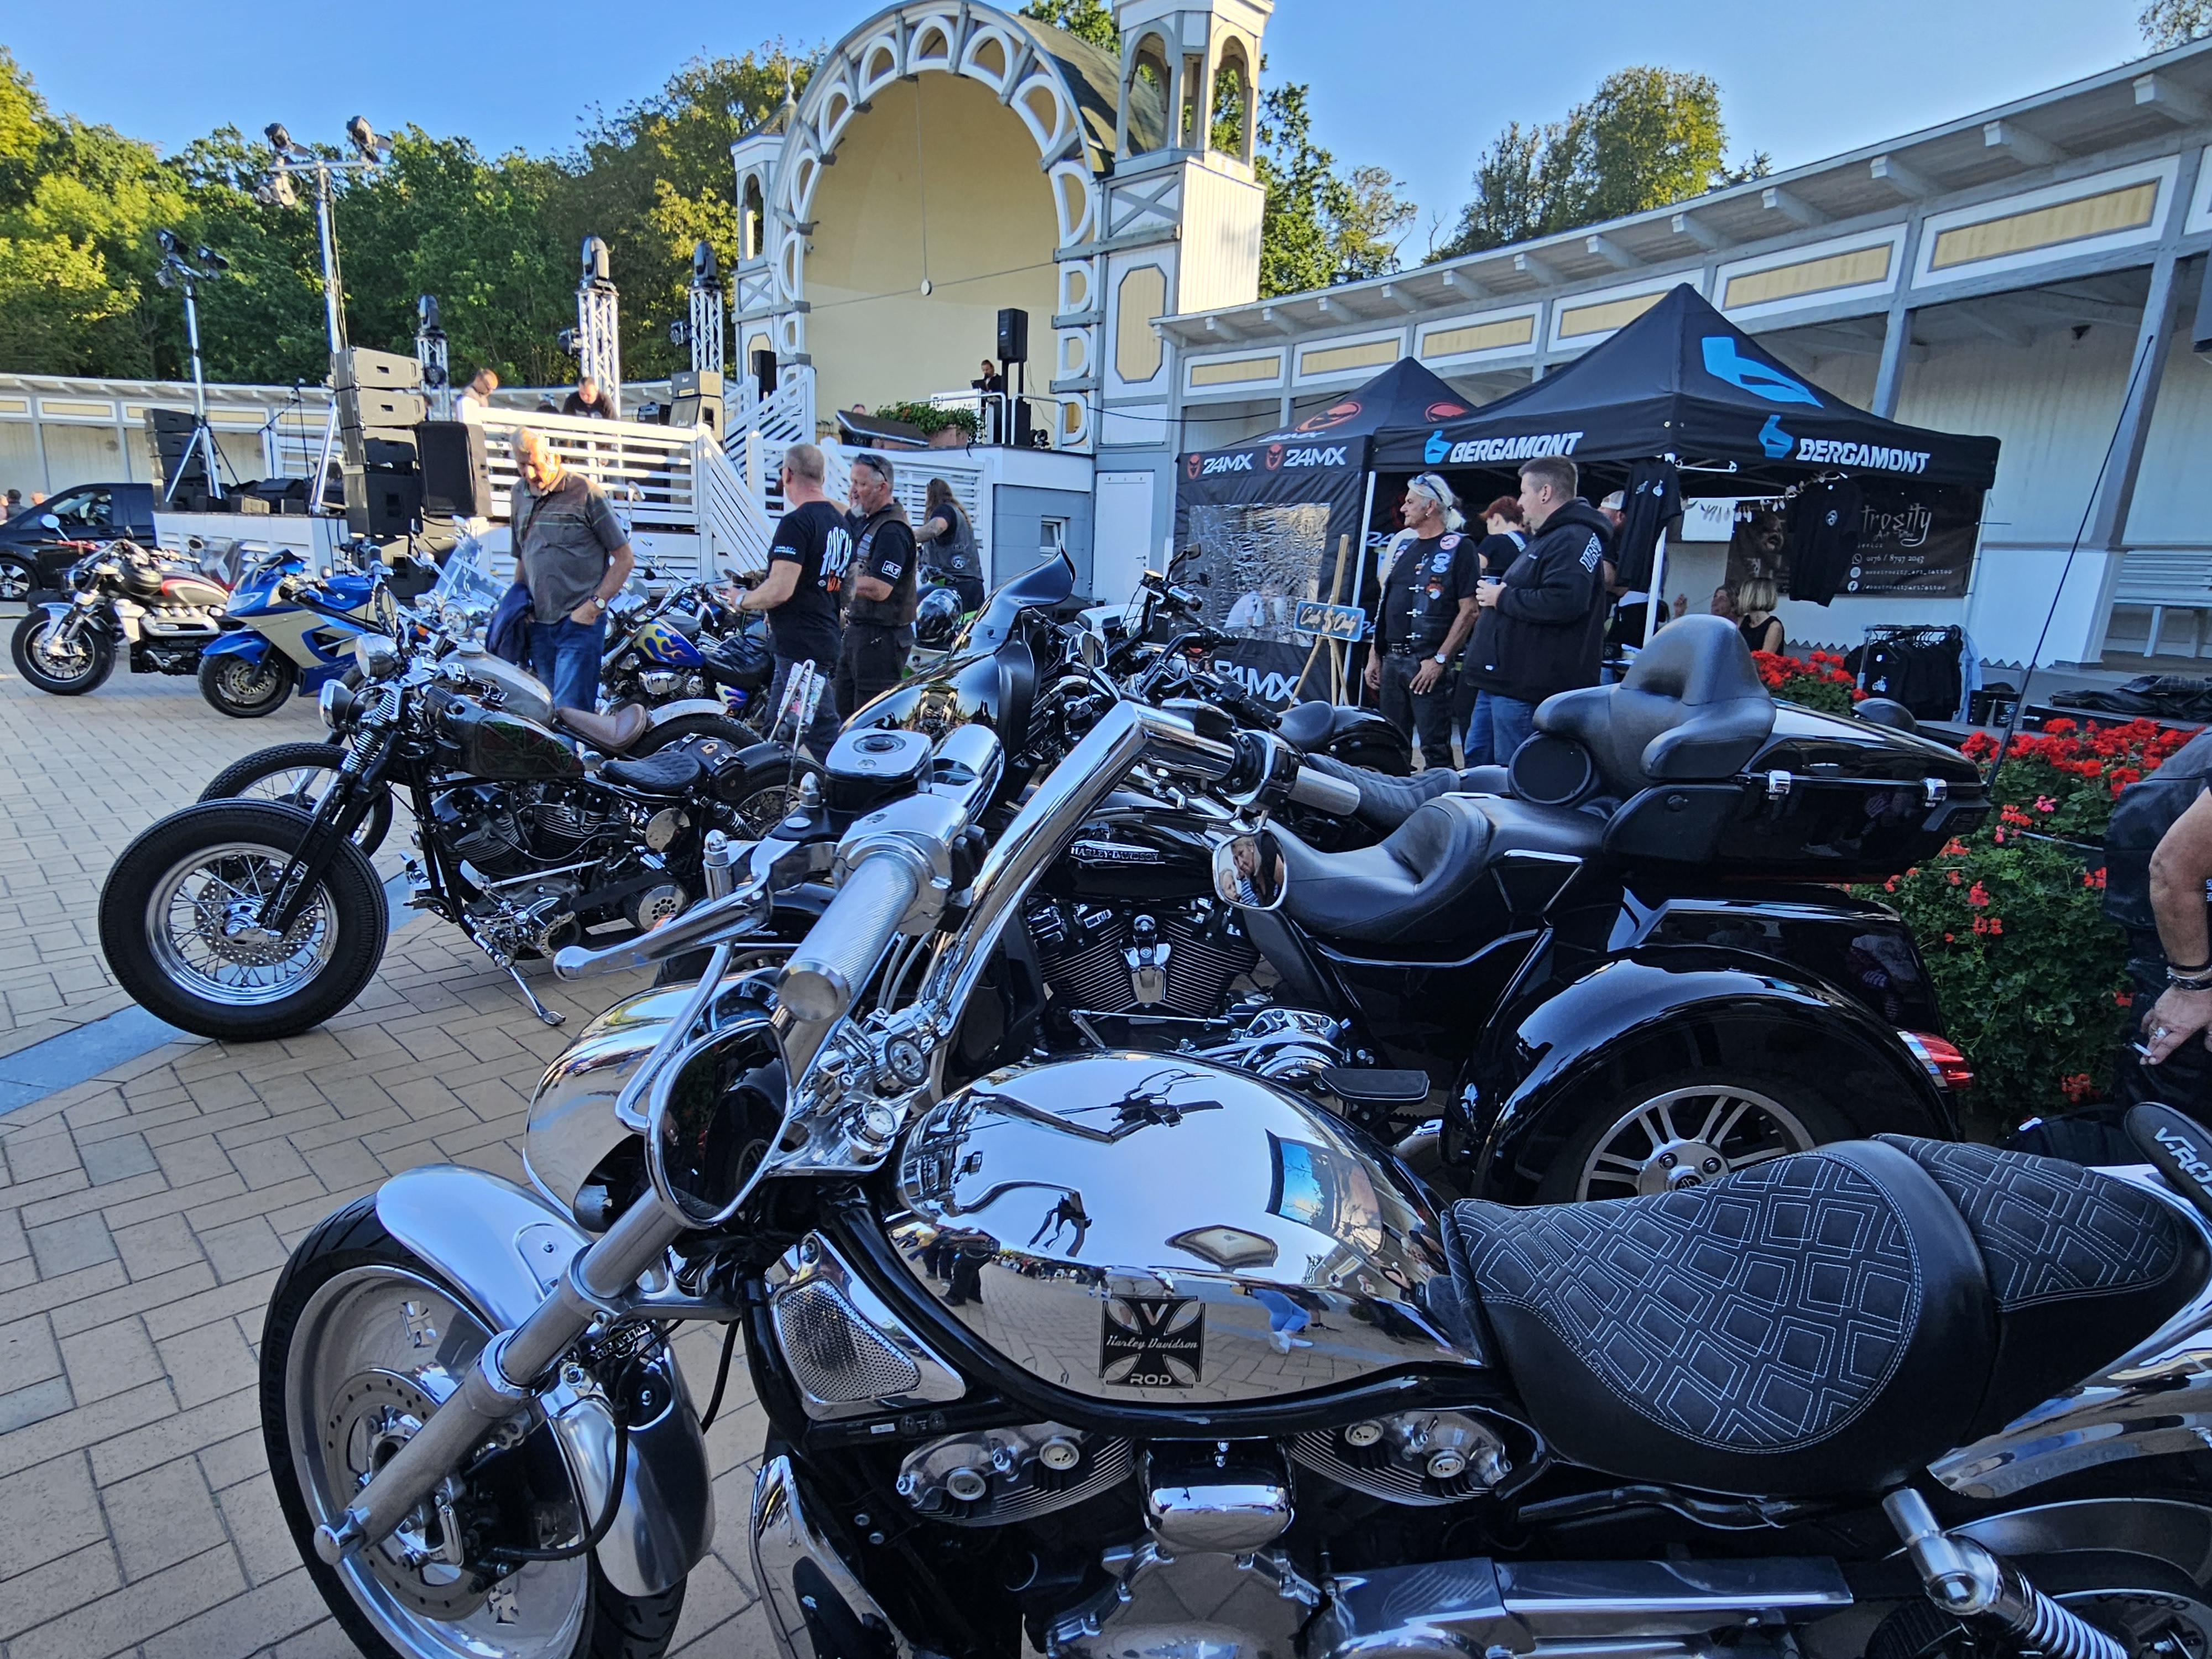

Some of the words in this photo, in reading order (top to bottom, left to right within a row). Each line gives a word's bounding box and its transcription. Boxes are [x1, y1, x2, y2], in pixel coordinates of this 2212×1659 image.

[1284, 446, 1347, 467] 24MX
[1449, 431, 1583, 463] BERGAMONT
[1796, 438, 1931, 474] BERGAMONT
[1202, 453, 1253, 474] 24MX
[1861, 503, 1932, 547] trosity
[1071, 846, 1158, 861] HARLEY-DAVIDSON
[1141, 1303, 1168, 1326] V
[1107, 1334, 1146, 1349] Harley
[1147, 1338, 1198, 1349] Davidson
[1130, 1373, 1172, 1385] ROD
